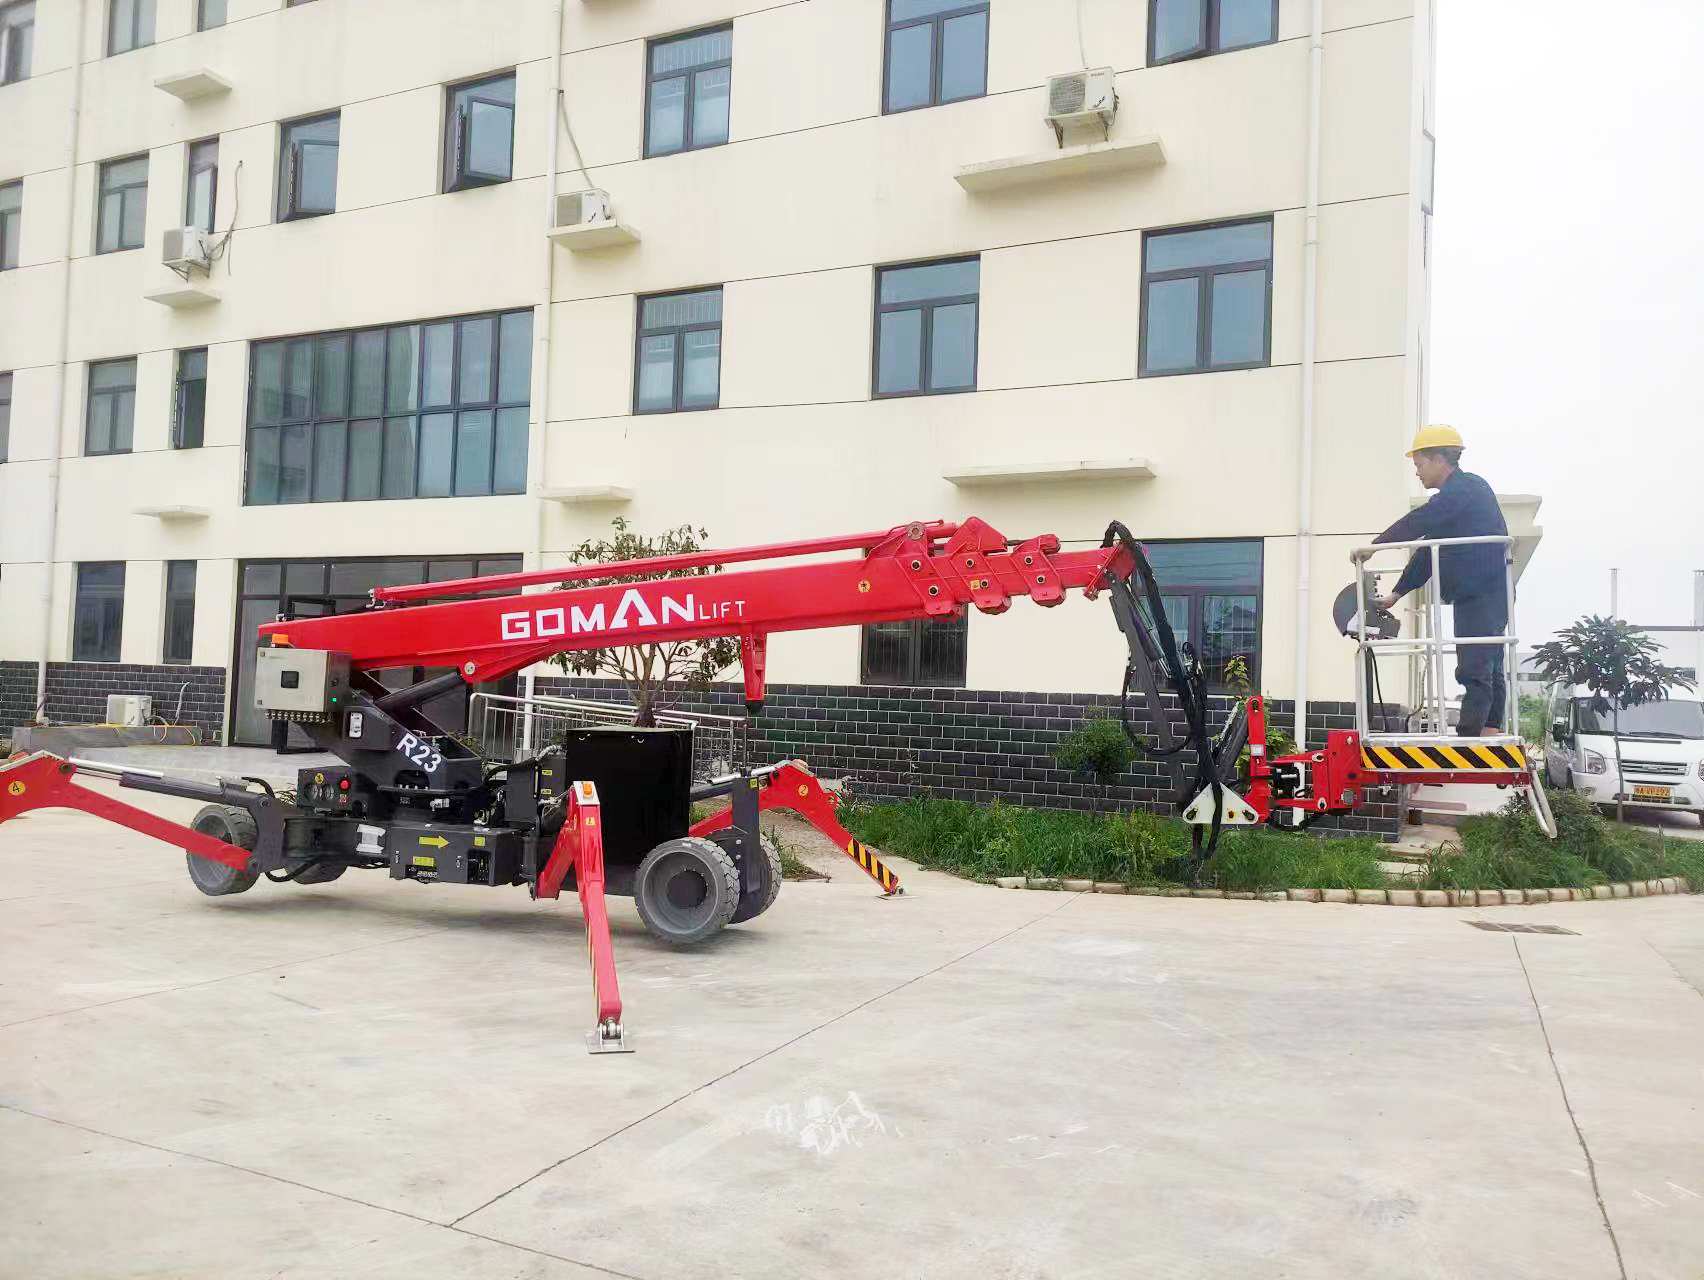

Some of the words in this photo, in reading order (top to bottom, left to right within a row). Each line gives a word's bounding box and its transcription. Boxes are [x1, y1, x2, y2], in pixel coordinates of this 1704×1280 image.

[501, 589, 695, 641] GOMAN
[699, 600, 746, 620] LIFT
[396, 732, 442, 773] R23
